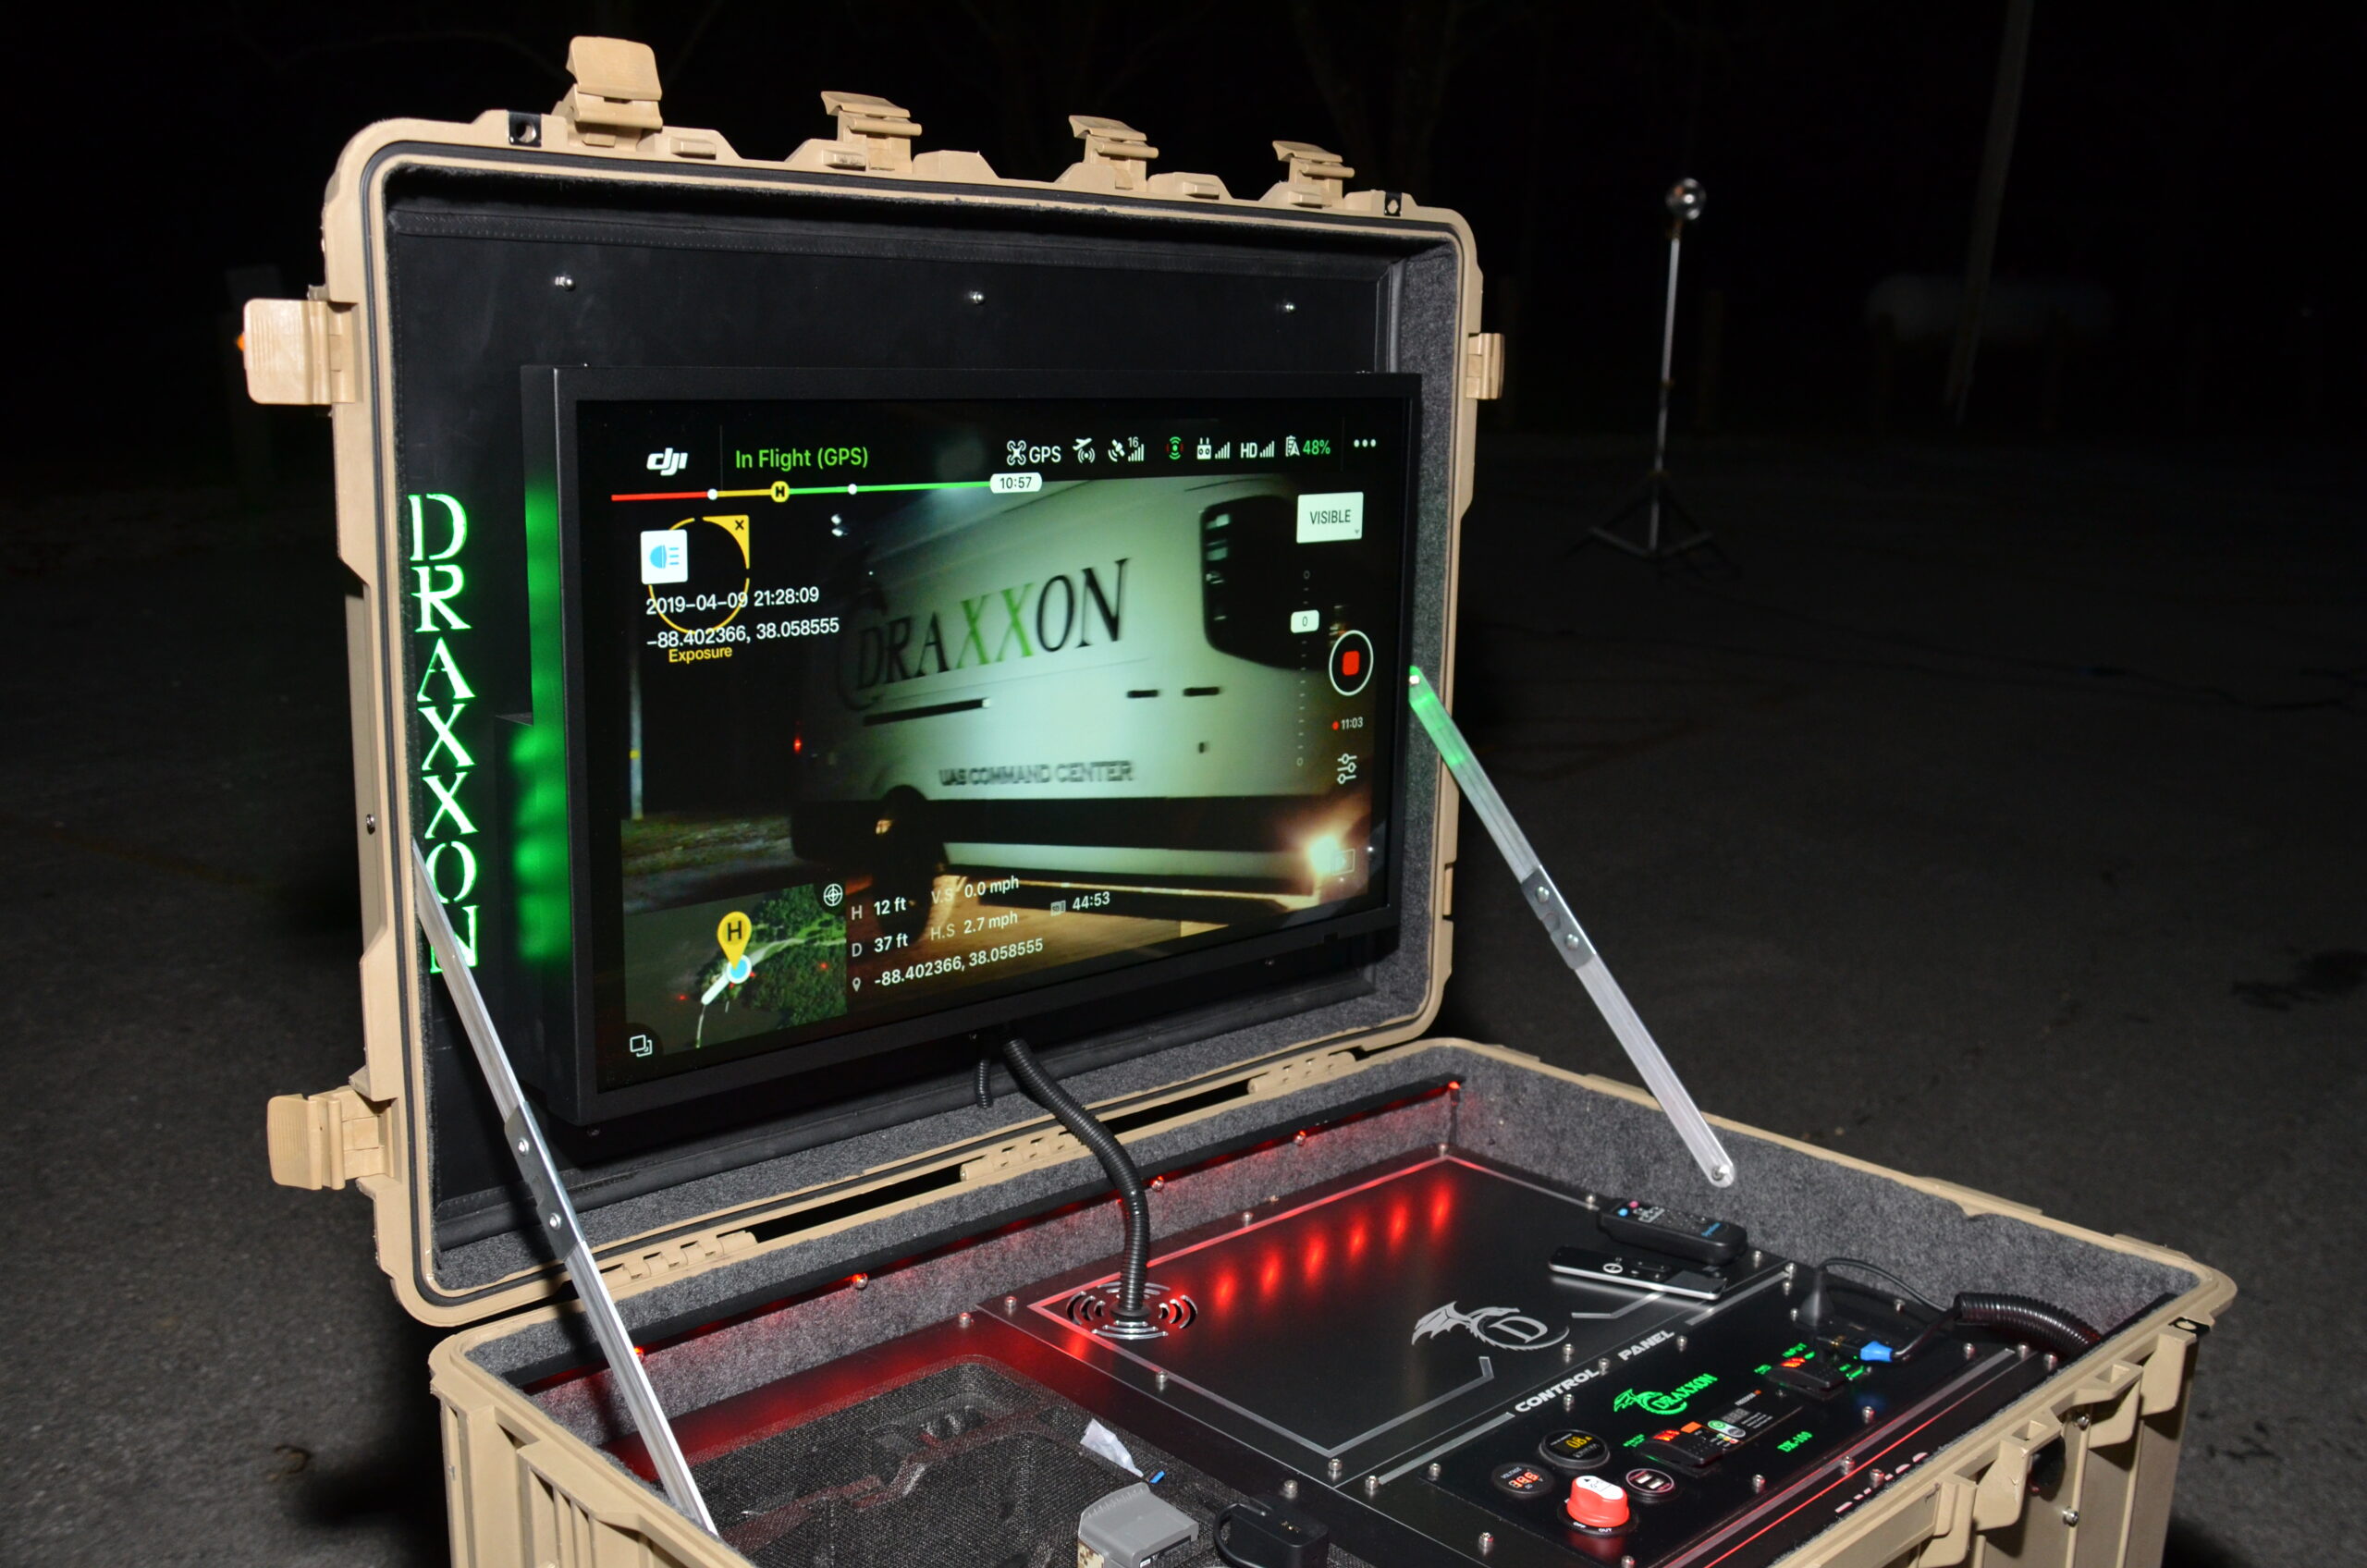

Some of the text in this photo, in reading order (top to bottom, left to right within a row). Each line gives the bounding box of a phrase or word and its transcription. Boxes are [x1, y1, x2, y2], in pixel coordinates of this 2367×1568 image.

[1128, 436, 1139, 448] 16
[1240, 442, 1257, 459] HD
[1303, 439, 1331, 456] 48%
[736, 447, 868, 472] In Flight (GPS)
[1028, 446, 1061, 463] GPS
[1000, 475, 1033, 490] 10:57
[1309, 508, 1352, 526] VISIBLE
[754, 586, 819, 608] 21:28:09
[647, 618, 840, 650] -88.402366, 38.058555
[856, 557, 1132, 691] DRAXXON
[668, 646, 732, 664] Exposure
[1341, 717, 1363, 729] 11:03
[967, 764, 1050, 785] COMMAND
[1056, 760, 1134, 782] CENTER
[964, 881, 983, 899] 0.0
[985, 876, 1020, 897] mph
[851, 897, 907, 920] H 12 ft
[1073, 891, 1110, 910] 44:53
[964, 917, 983, 935] 2.7
[985, 911, 1019, 932] mph
[851, 933, 909, 958] D 37 ft
[874, 937, 1044, 987] -88.402366, 38.058555
[1515, 1329, 1674, 1413] CONTROL PANEL
[1650, 1373, 1718, 1408] DRAXXON
[1777, 1431, 1813, 1453] DX-100
